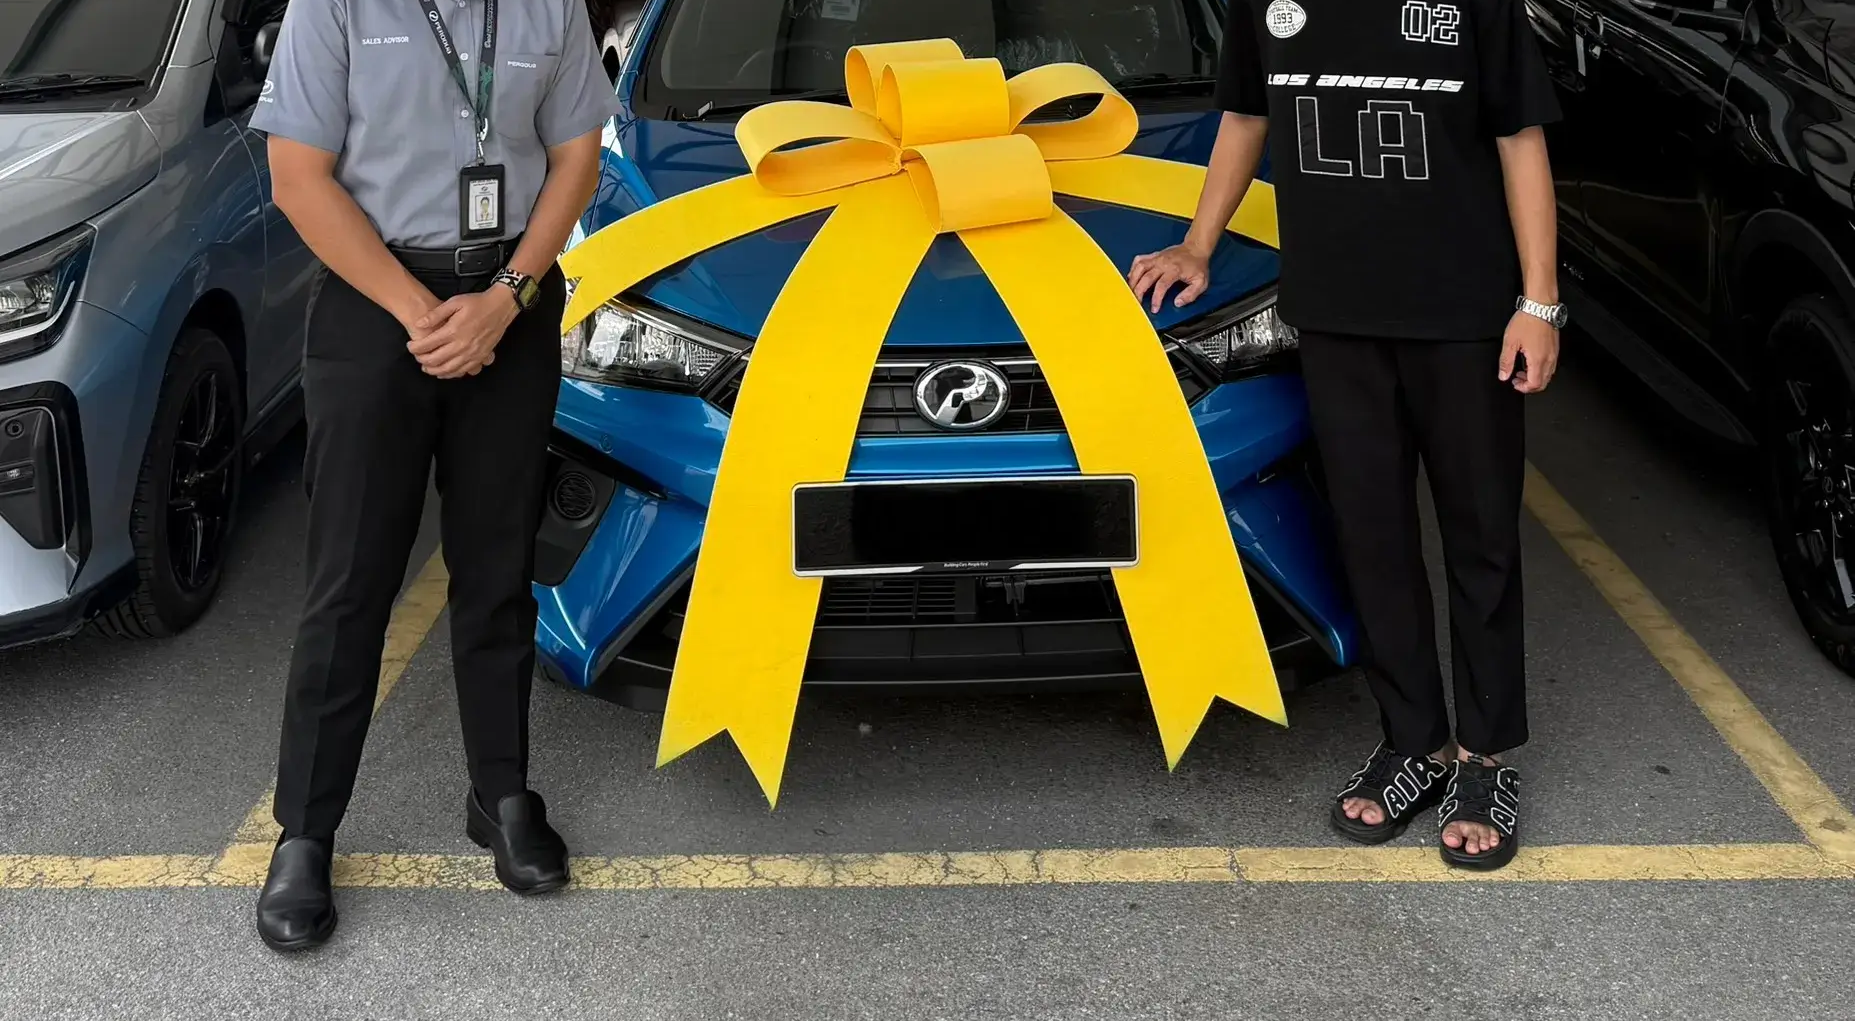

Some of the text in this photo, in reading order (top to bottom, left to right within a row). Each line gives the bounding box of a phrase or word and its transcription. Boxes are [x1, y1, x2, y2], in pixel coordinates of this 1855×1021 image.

[1273, 13, 1293, 25] 1993
[1401, 0, 1460, 45] 02
[362, 35, 409, 45] SALES ADVISOR
[1267, 73, 1464, 92] LOS ANGELES
[1295, 96, 1430, 180] LA
[1383, 754, 1448, 819] AIR
